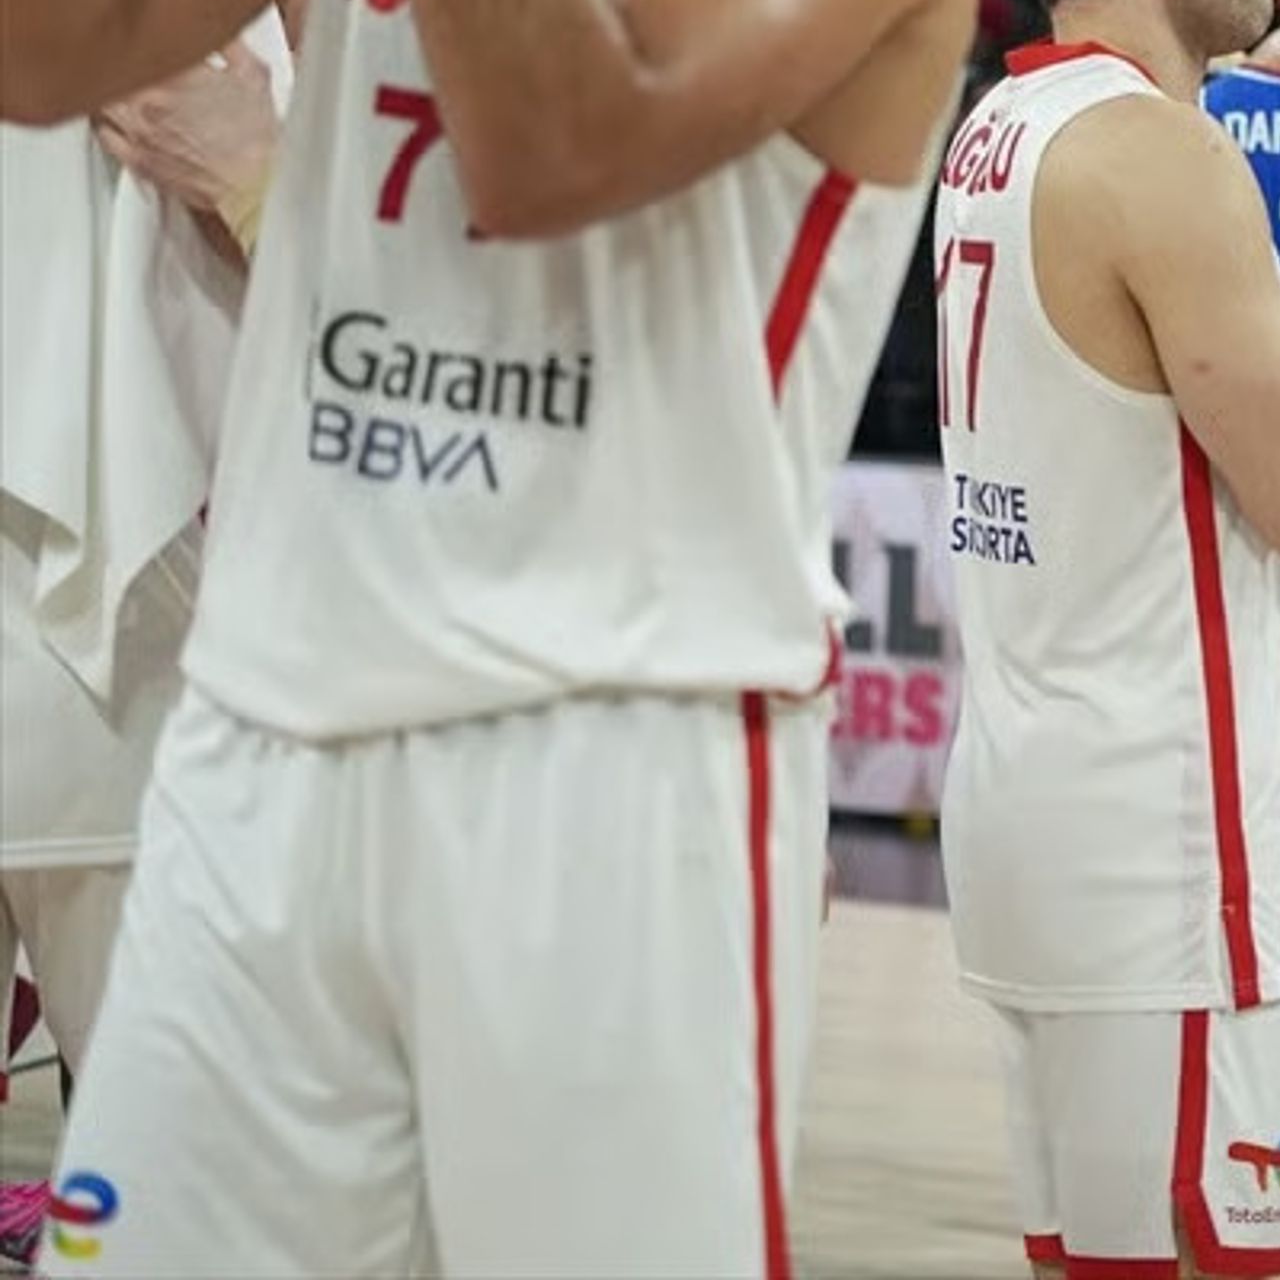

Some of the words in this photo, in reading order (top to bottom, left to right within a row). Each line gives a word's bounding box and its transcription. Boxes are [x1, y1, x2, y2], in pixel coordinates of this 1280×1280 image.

[321, 310, 592, 429] Garanti
[935, 237, 995, 432] 17
[309, 401, 498, 492] BBVA
[831, 670, 944, 745] RS
